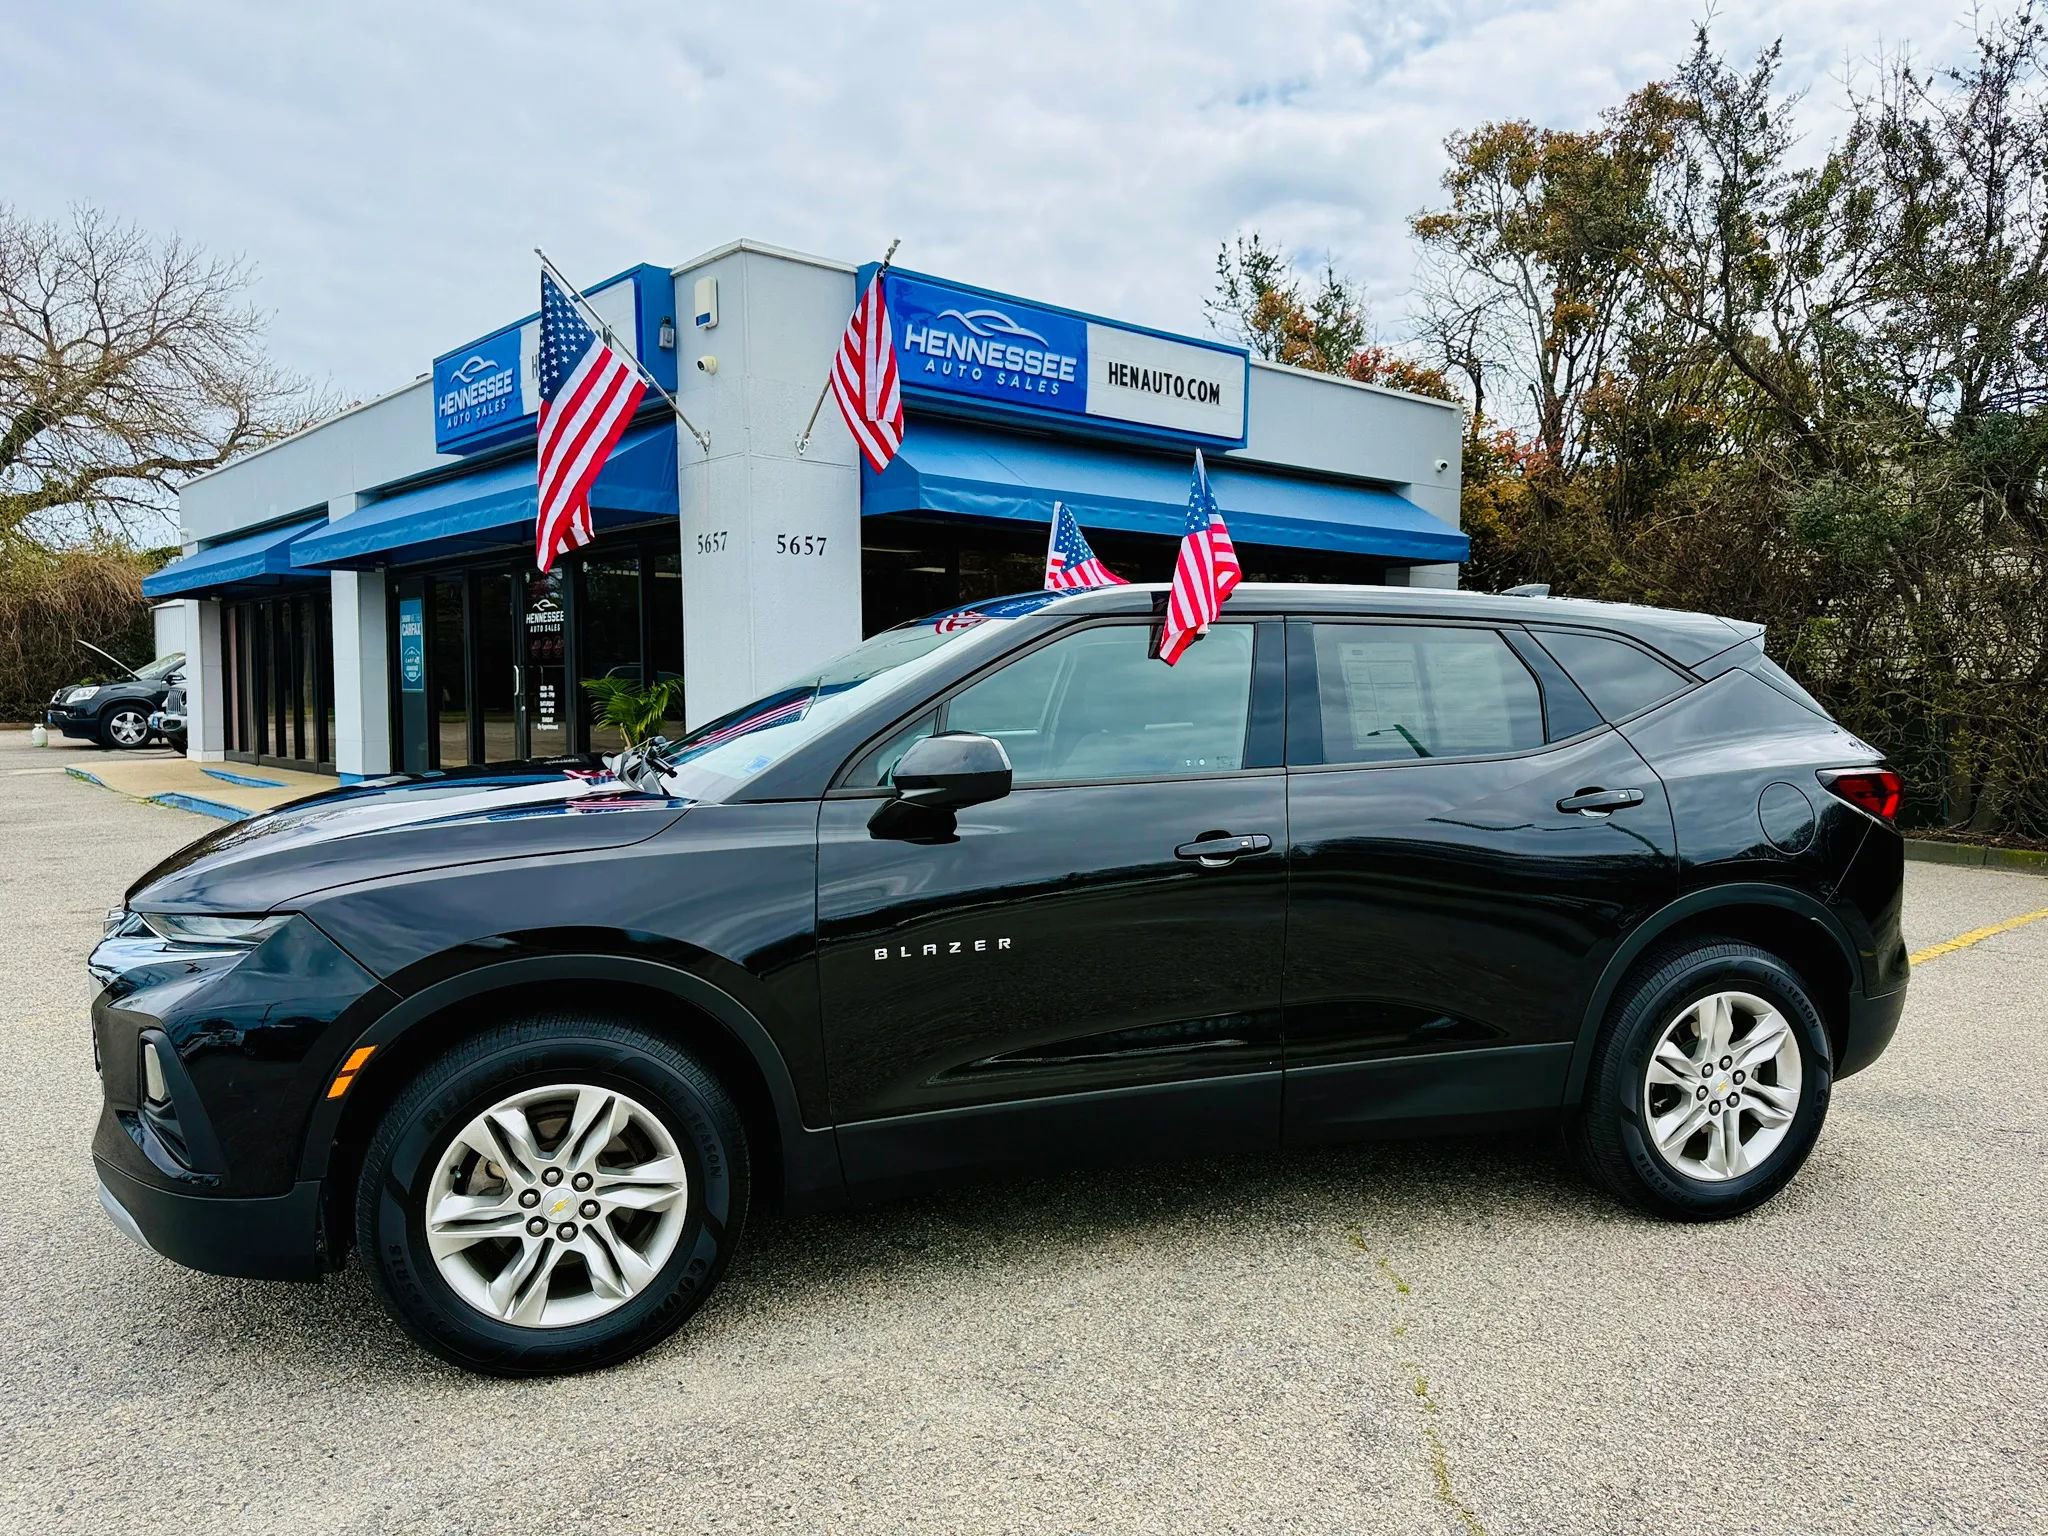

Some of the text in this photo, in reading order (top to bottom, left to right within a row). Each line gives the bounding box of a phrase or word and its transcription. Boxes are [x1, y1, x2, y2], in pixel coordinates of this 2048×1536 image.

[904, 324, 1077, 382] HENNESSEE
[925, 359, 1060, 395] AUTO SALES
[439, 368, 514, 418] HENNESSEE
[447, 400, 507, 429] AUTO SALES
[697, 531, 728, 555] 5657
[776, 533, 827, 556] 5657
[526, 610, 564, 624] HENNESSEE
[545, 624, 560, 632] SALES
[874, 937, 1011, 961] BLAZER
